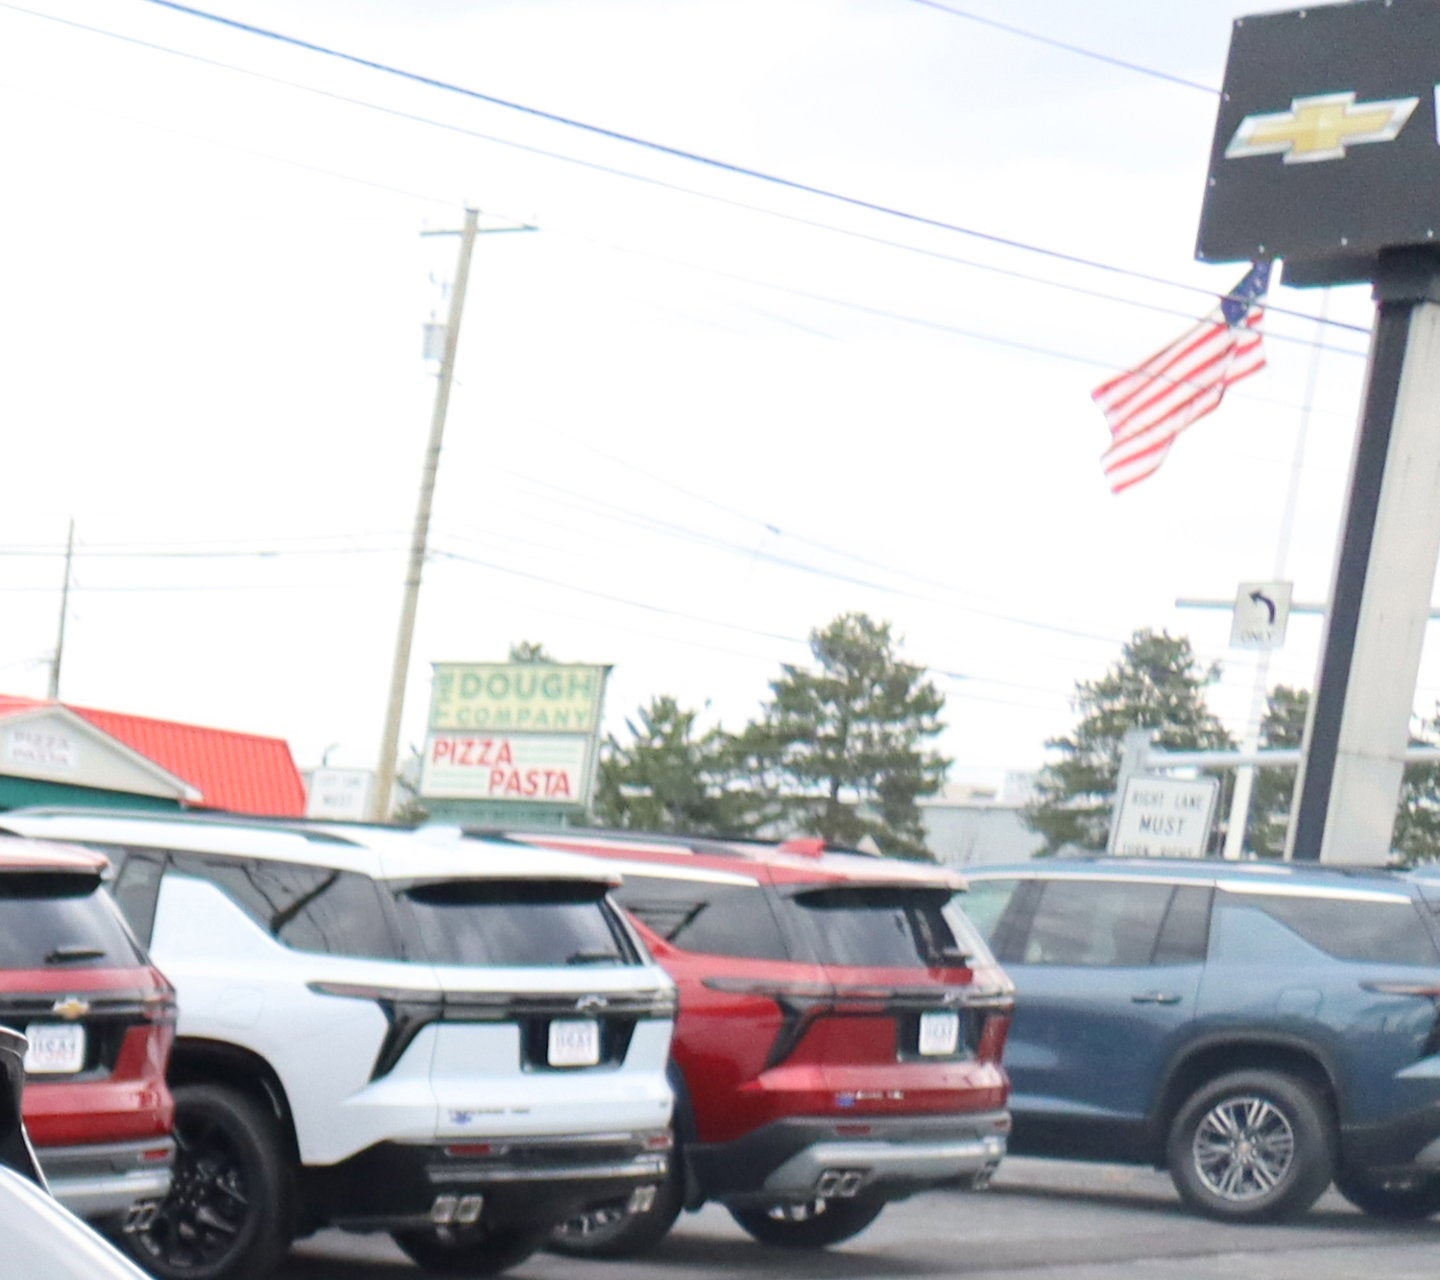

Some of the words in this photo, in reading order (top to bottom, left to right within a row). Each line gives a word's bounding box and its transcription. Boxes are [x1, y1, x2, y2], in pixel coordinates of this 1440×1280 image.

[459, 672, 591, 700] DOUGH
[456, 707, 587, 727] COMPANY
[433, 737, 512, 767] PIZZA
[488, 768, 570, 797] PASTA
[1140, 814, 1184, 836] MUST
